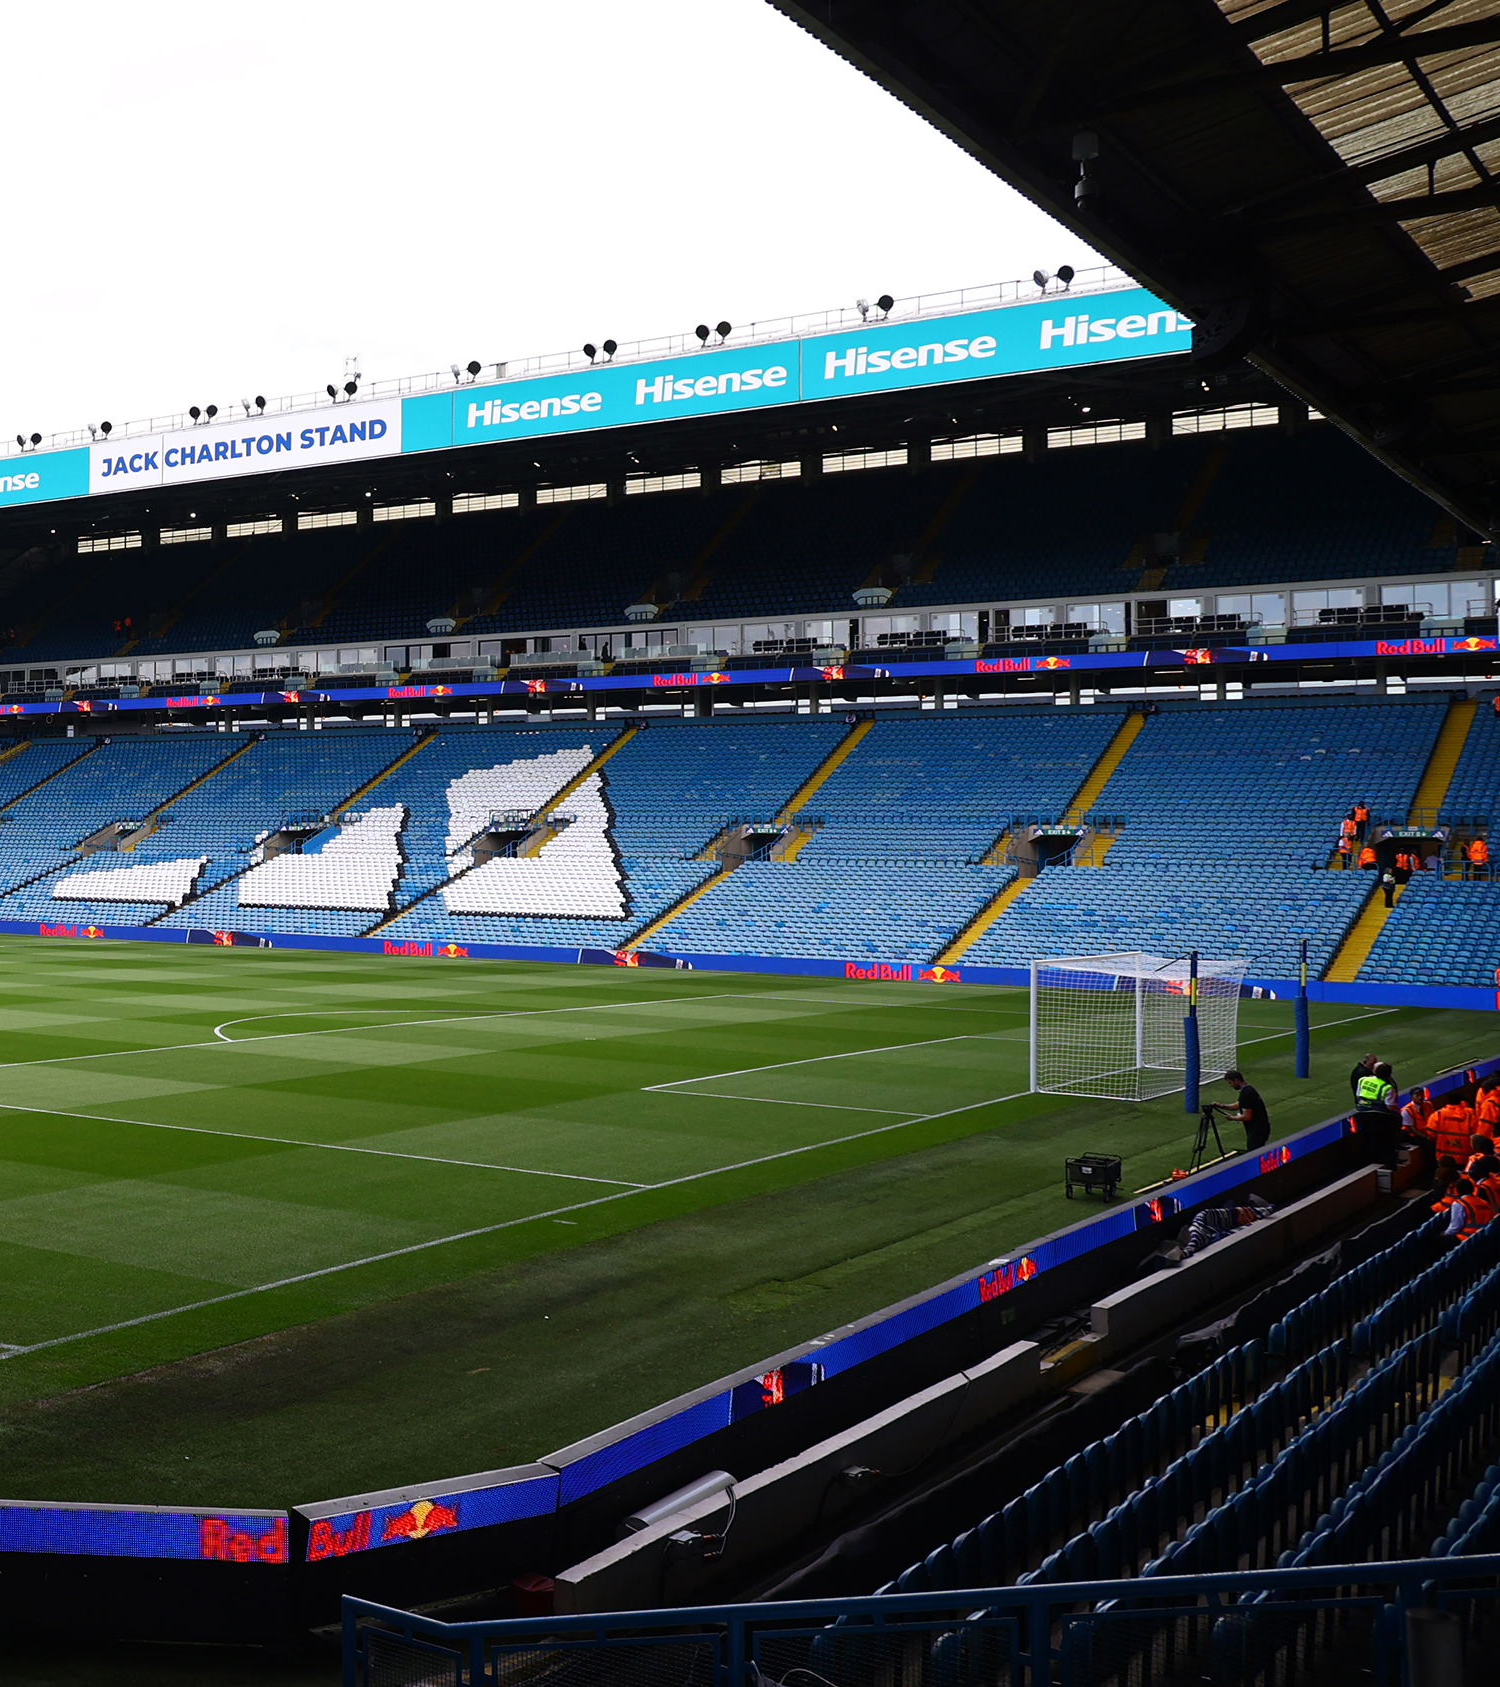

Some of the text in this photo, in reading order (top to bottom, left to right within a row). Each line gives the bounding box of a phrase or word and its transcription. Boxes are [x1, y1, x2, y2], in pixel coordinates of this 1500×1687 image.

[825, 336, 997, 379] Hisense
[635, 366, 788, 405] Hisense
[467, 392, 603, 428] Hisense
[102, 419, 387, 477] JACK CHARLTON STAND
[200, 1517, 288, 1563] Red
[308, 1513, 371, 1562] Bull
